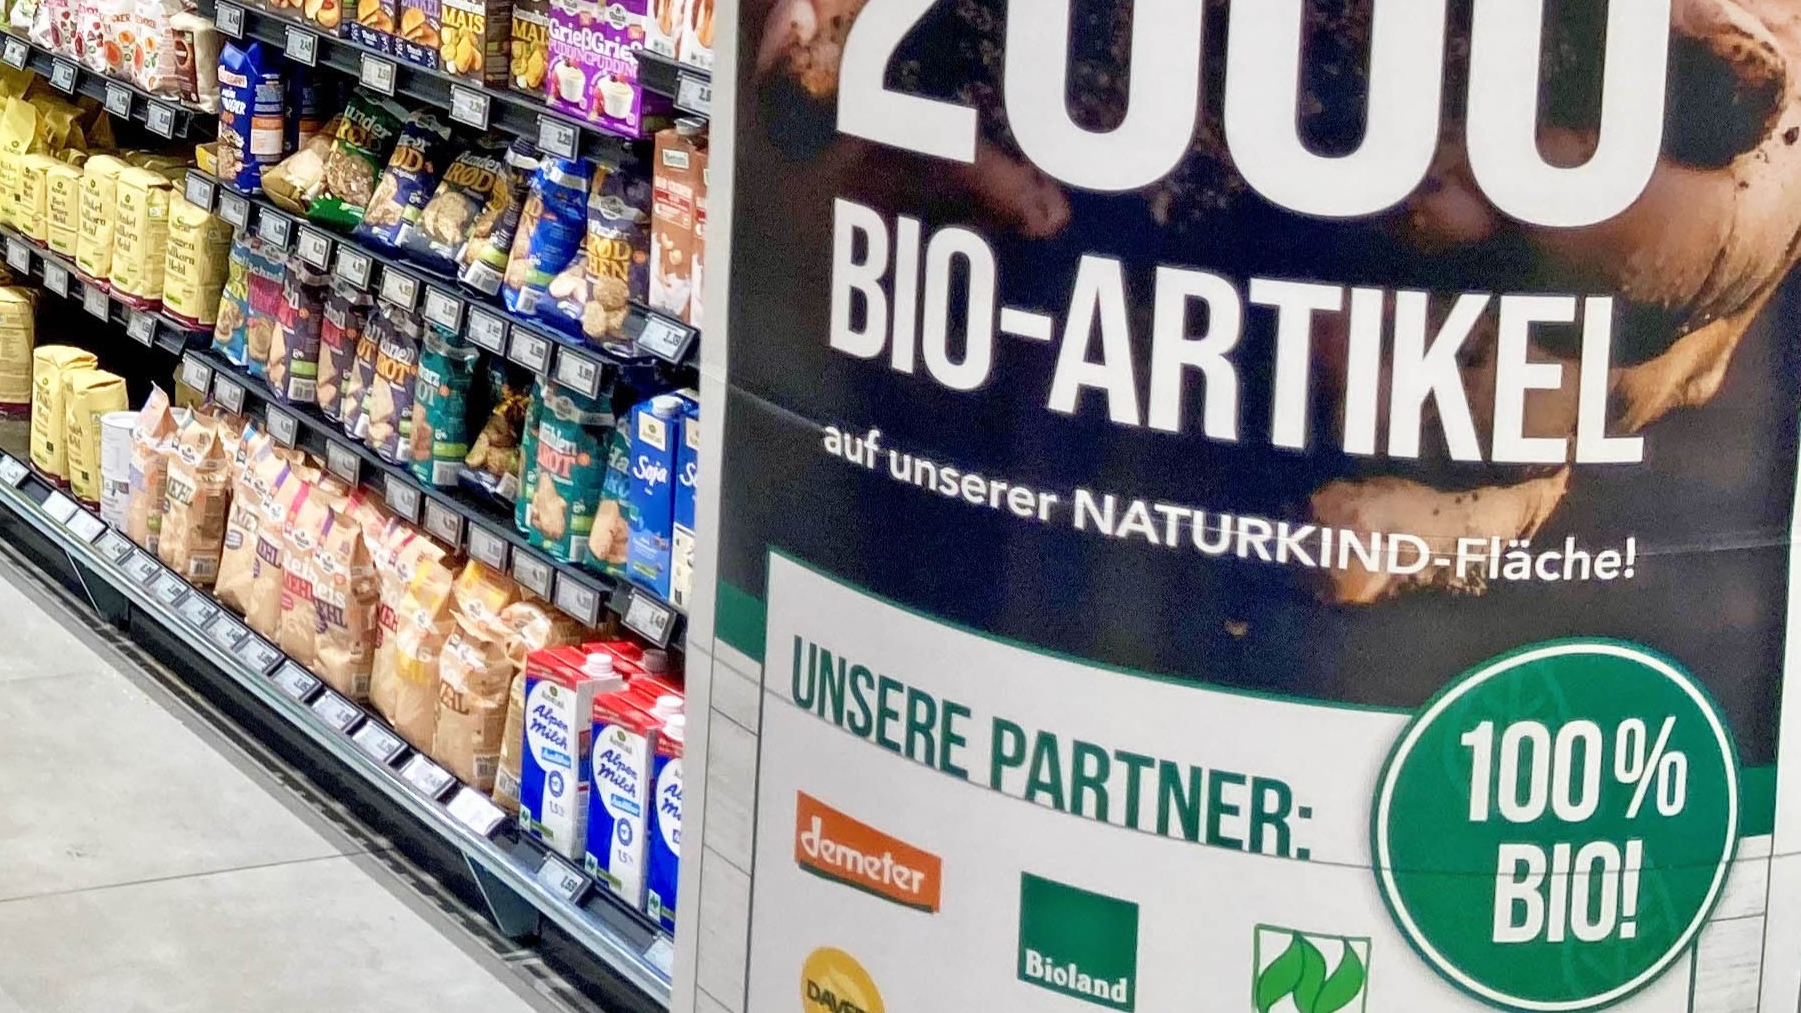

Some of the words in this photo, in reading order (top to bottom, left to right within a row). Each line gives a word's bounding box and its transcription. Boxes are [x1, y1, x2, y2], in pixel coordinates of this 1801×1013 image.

[442, 5, 485, 35] MAIS
[344, 103, 393, 138] under
[443, 161, 497, 193] RØD
[829, 197, 1644, 465] BIO-ARTIKEL
[632, 455, 668, 486] Soja
[823, 421, 882, 467] auf
[889, 449, 1057, 522] unserer
[1072, 489, 1637, 582] NATURKIND-Fläche!
[529, 718, 568, 751] Milch
[532, 704, 569, 734] Alpen
[600, 749, 638, 781] Alpen
[792, 635, 972, 782] UNSERE
[990, 716, 1314, 860] PARTNER:
[597, 763, 637, 799] Milch
[800, 816, 926, 895] demeter
[1491, 841, 1639, 944] BIO!
[1024, 948, 1128, 1005] Bioland
